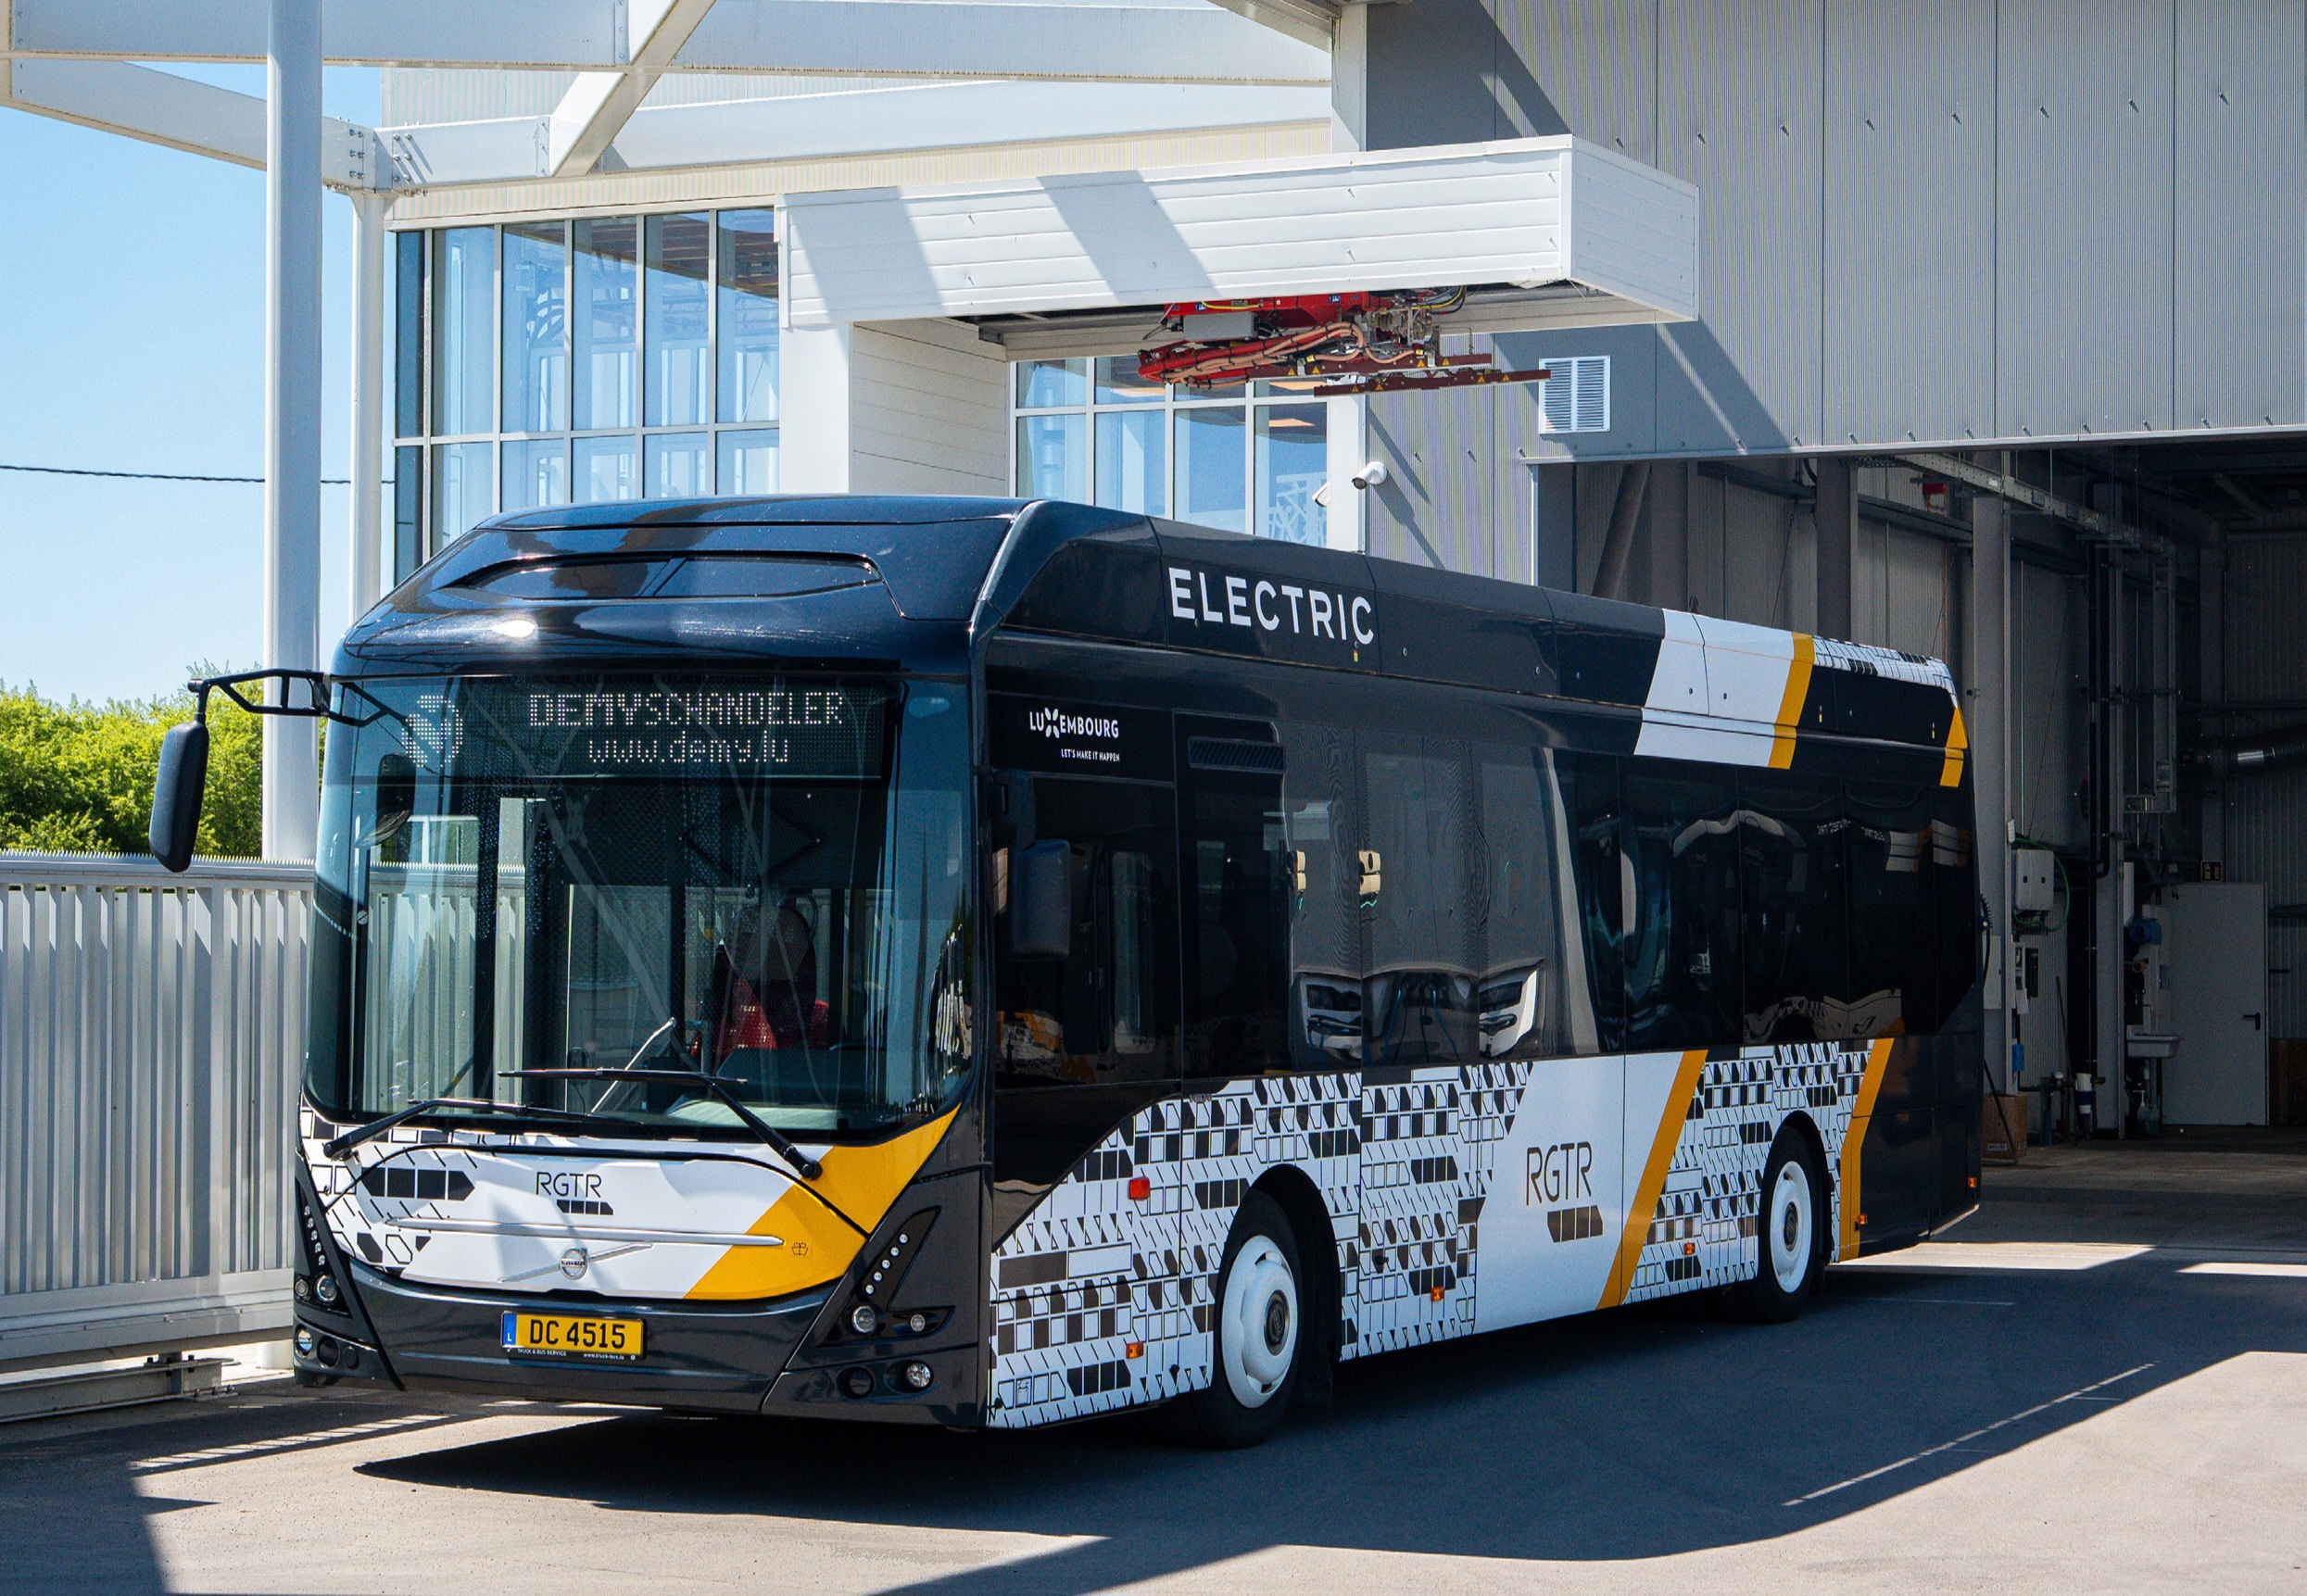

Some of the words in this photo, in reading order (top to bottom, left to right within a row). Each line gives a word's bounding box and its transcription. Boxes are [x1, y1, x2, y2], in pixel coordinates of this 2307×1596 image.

[1168, 567, 1374, 646] ELECTRIC
[1029, 707, 1119, 738] LUXEMBOURG
[588, 730, 788, 763] www.demy.lu
[1061, 748, 1076, 759] LET'S
[1077, 749, 1091, 760] MAKE
[1092, 750, 1098, 760] IT
[1099, 751, 1120, 762] HAPPEN
[536, 1171, 602, 1198] RGTR
[1526, 1140, 1593, 1206] RGTR
[507, 1333, 512, 1342] L
[529, 1319, 560, 1345] DC
[566, 1322, 625, 1350] 4515
